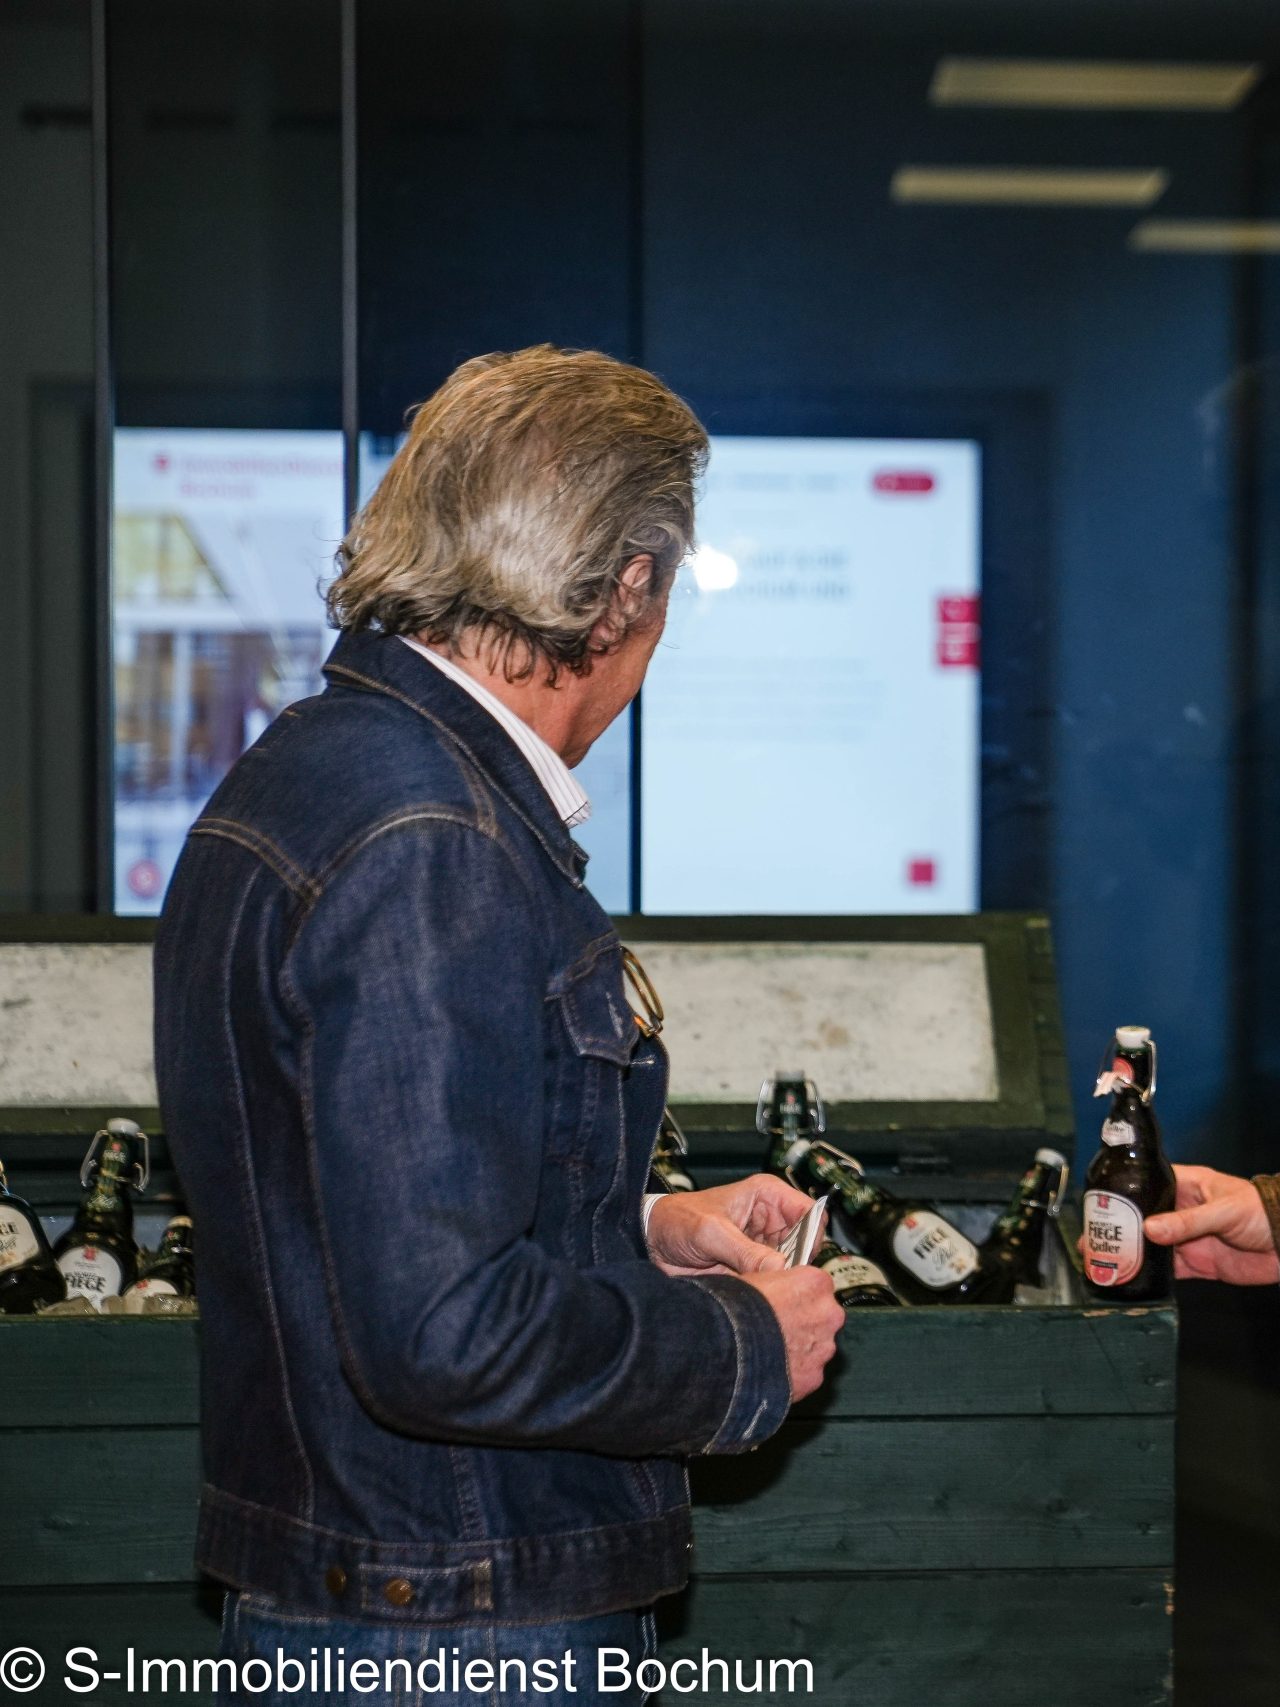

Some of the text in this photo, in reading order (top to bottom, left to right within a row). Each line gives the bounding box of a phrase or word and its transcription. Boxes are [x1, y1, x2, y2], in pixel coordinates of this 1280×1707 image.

[1088, 1220, 1123, 1242] FIEGE
[1088, 1238, 1121, 1254] Radler
[64, 1271, 106, 1294] FIEGE
